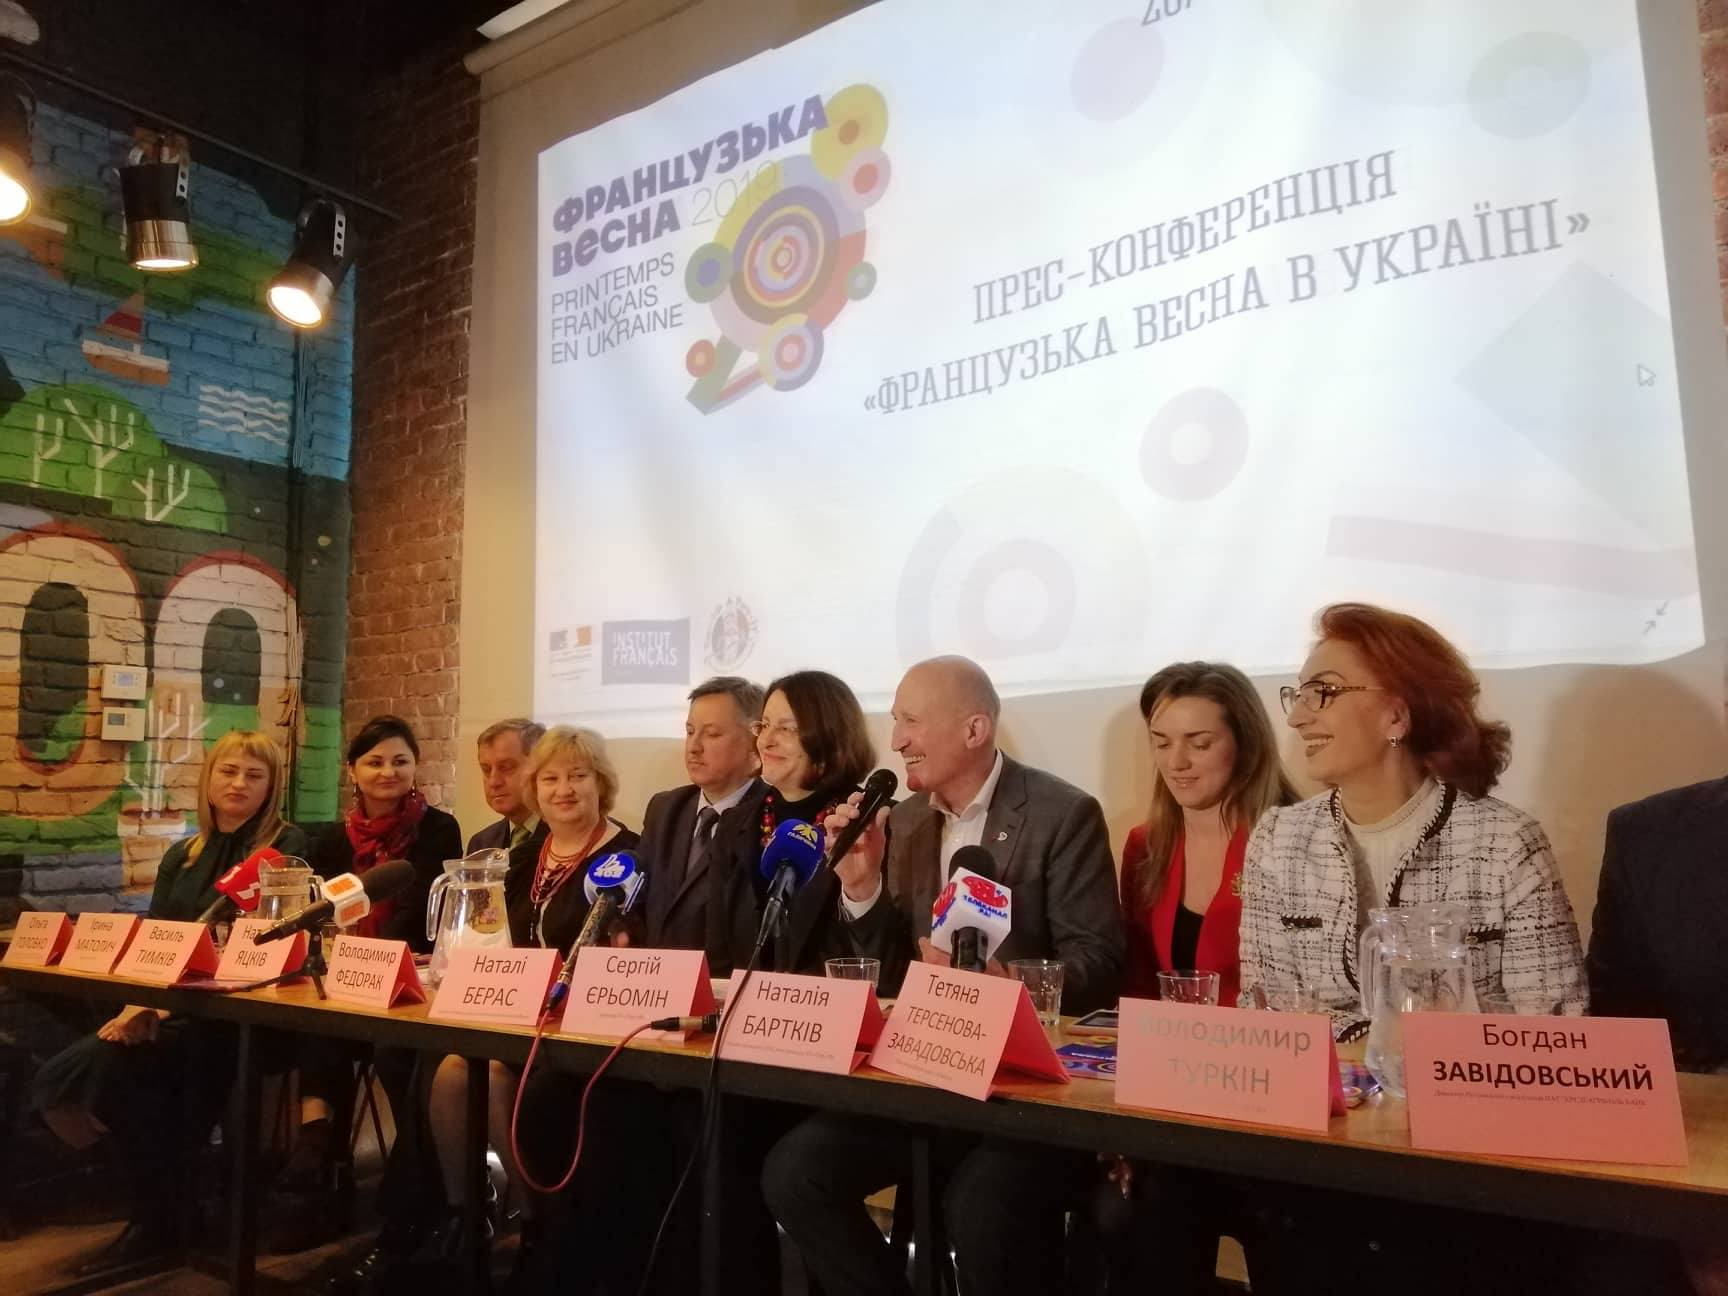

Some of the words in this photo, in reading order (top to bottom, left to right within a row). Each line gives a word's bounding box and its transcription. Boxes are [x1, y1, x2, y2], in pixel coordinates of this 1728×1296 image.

[552, 94, 829, 234] ФРАНЦУЗЬКА
[552, 252, 675, 315] PRINTEMPS
[552, 285, 658, 339] FRANÇAIS
[863, 316, 1118, 415] «ФРАНЦУЗЬКА
[1133, 266, 1270, 351] ВЕСНА
[1287, 253, 1320, 304] В
[1335, 199, 1590, 293] УКРАЇНІ»
[551, 340, 579, 365] EN
[586, 303, 684, 358] UKRAINE
[613, 631, 671, 650] INSTITUT
[149, 926, 184, 943] Василь
[136, 949, 177, 966] ТИМКІВ
[235, 950, 268, 968] ЯЦКІВ
[338, 942, 397, 966] Володимир
[473, 955, 528, 975] Наталі
[606, 955, 661, 978] Сергій
[335, 969, 384, 991] ФЕДОРАК
[757, 980, 830, 1008] Наталія
[927, 974, 980, 1005] Тетяна
[463, 986, 518, 1007] БЕРАС
[586, 986, 669, 1009] ЄРЬОМІН
[743, 1015, 823, 1043] БАРТКІВ
[906, 1006, 987, 1041] ТЕРСЕНОВА-
[1482, 1023, 1587, 1053] Богдан
[887, 1032, 986, 1077] ЗАВАДОВСЬКА
[1168, 1058, 1271, 1095] ТУРКІН
[1433, 1060, 1653, 1091] ЗАВІДОВСЬКИЙ
